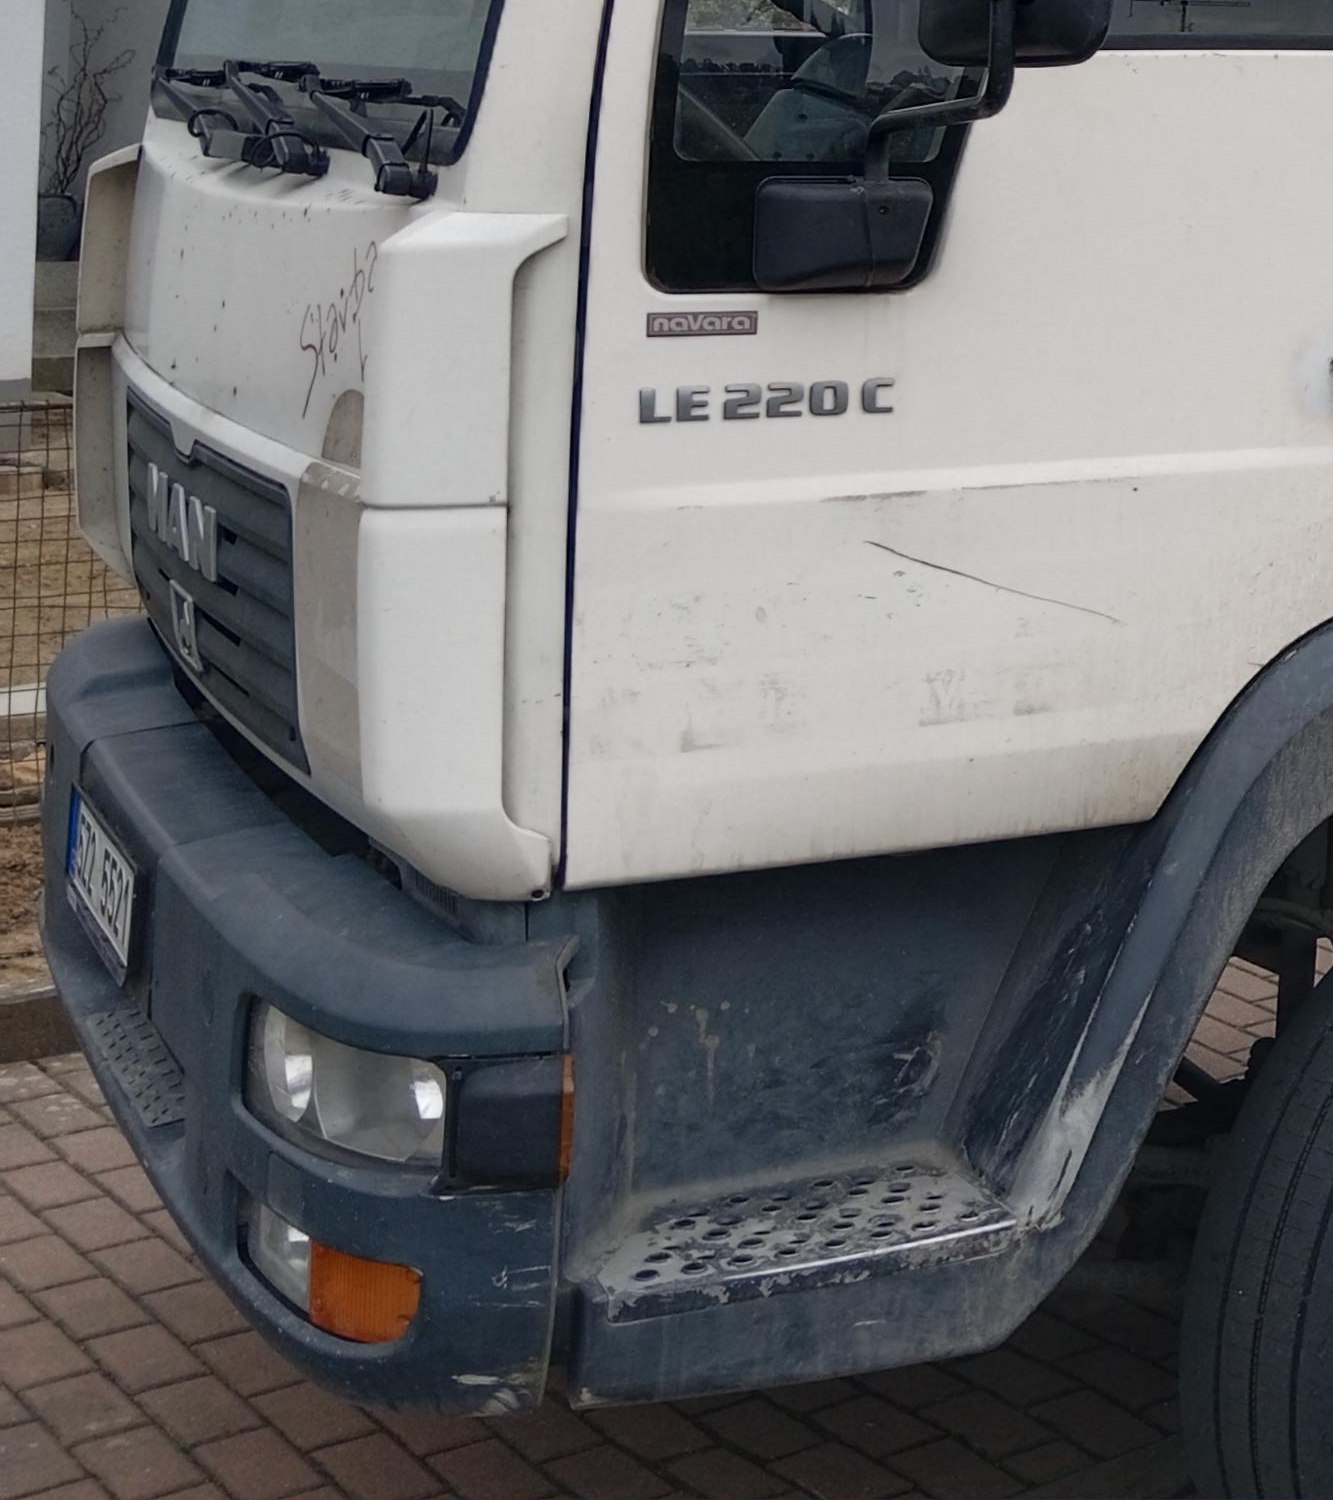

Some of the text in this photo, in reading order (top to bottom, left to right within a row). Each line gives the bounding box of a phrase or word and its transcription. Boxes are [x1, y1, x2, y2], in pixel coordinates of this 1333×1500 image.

[639, 377, 896, 423] LE 220 C
[147, 462, 218, 584] MAN
[101, 847, 130, 947] 5521
